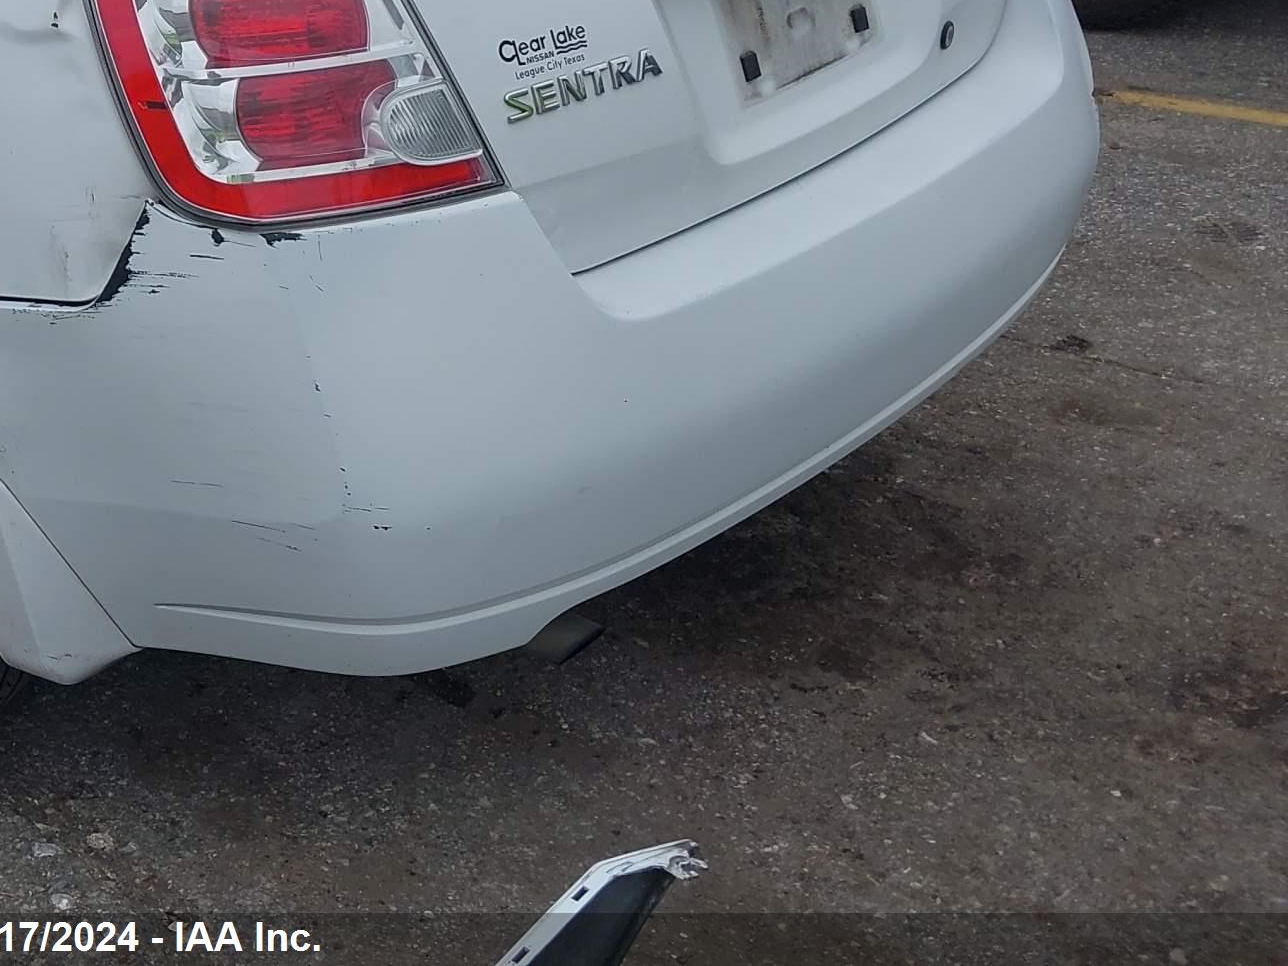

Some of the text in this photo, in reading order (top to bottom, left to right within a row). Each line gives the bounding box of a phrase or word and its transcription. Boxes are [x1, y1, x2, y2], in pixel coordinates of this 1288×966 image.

[550, 25, 587, 50] Lake
[515, 54, 585, 81] League City Texas
[526, 51, 555, 65] NISSAN
[504, 48, 663, 124] SENTRA
